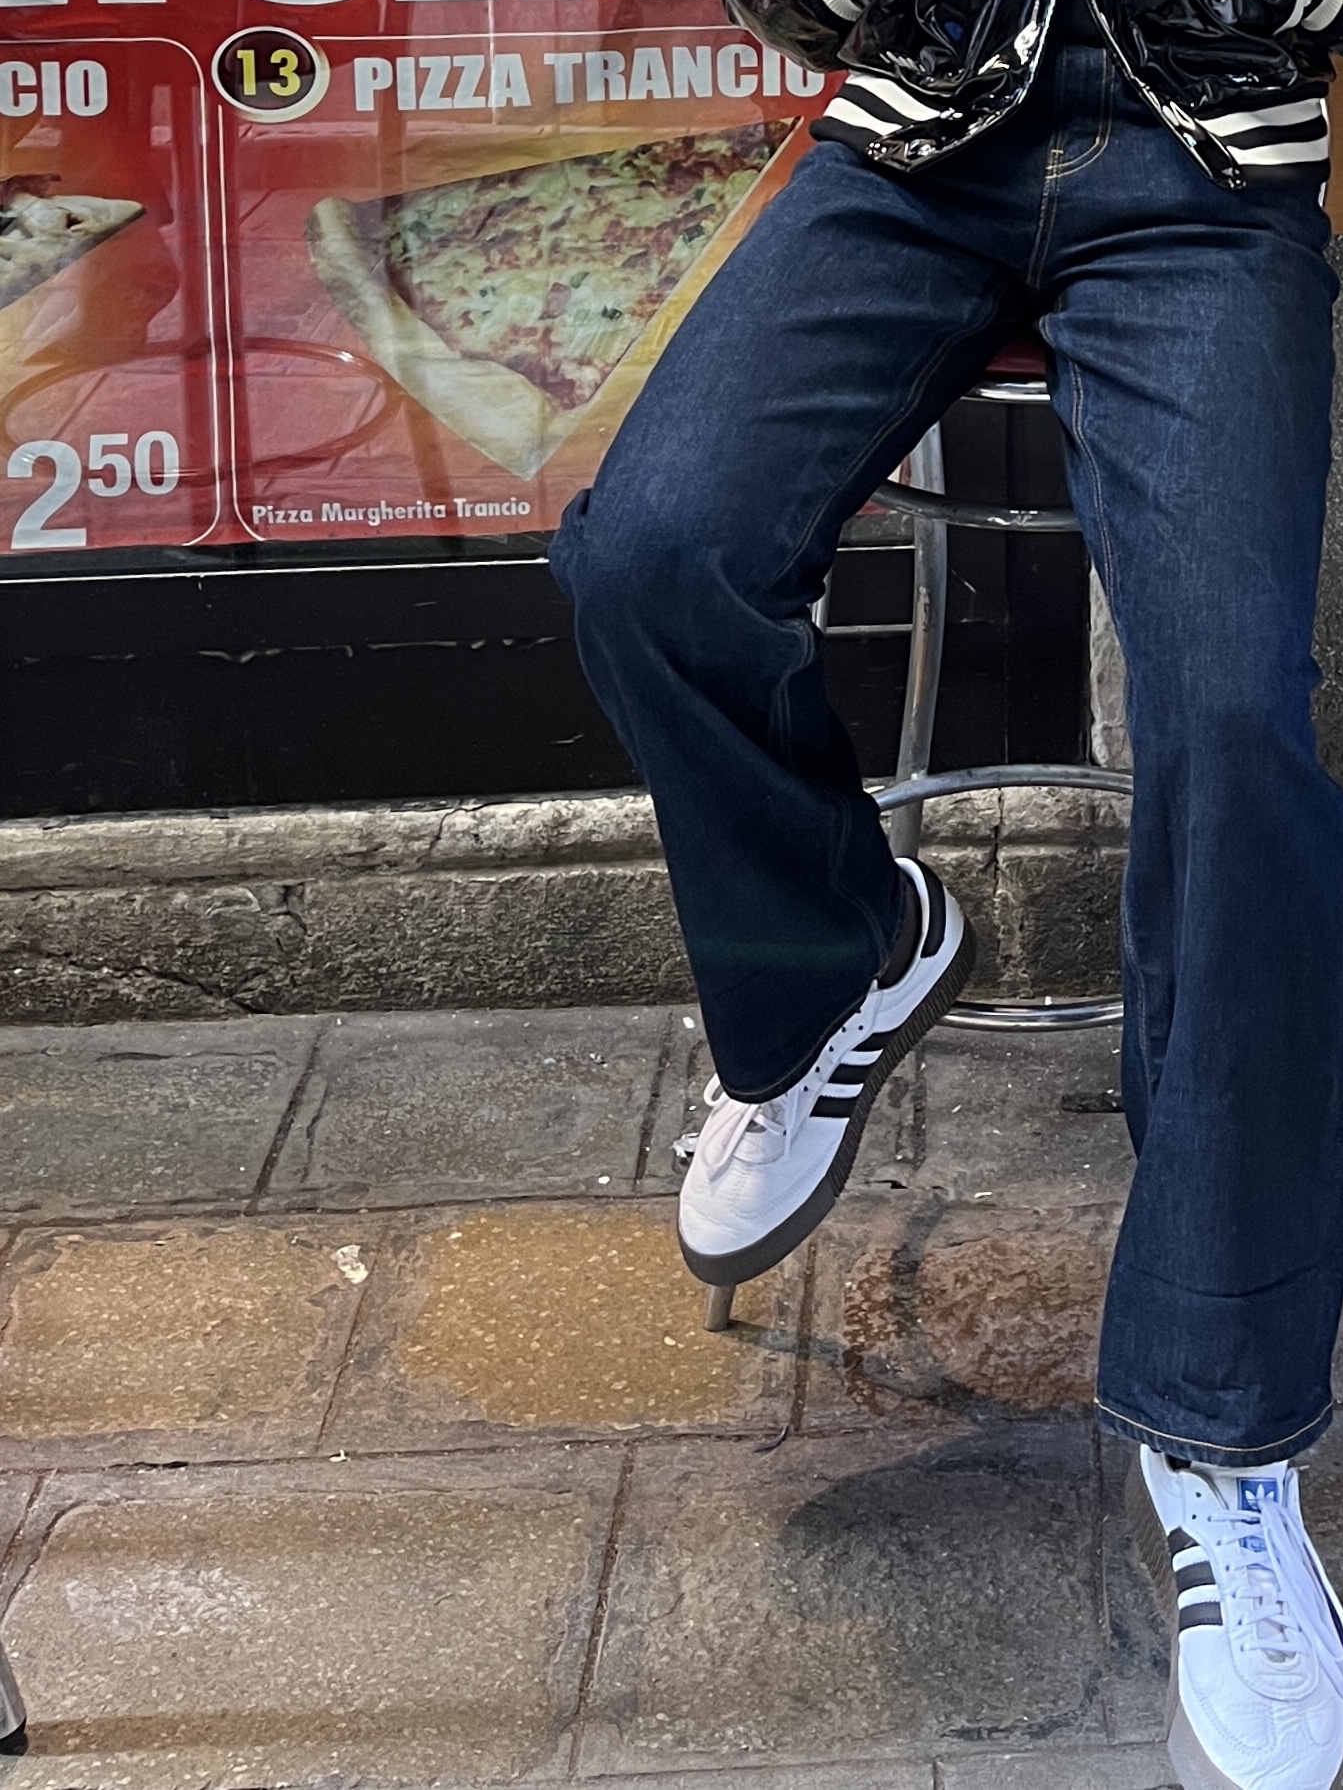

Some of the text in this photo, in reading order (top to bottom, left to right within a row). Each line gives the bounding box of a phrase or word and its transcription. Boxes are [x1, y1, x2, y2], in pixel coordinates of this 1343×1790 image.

[235, 48, 301, 97] 13
[355, 52, 531, 112] PIZZA
[251, 495, 531, 527] Pizza Margherita Trancio
